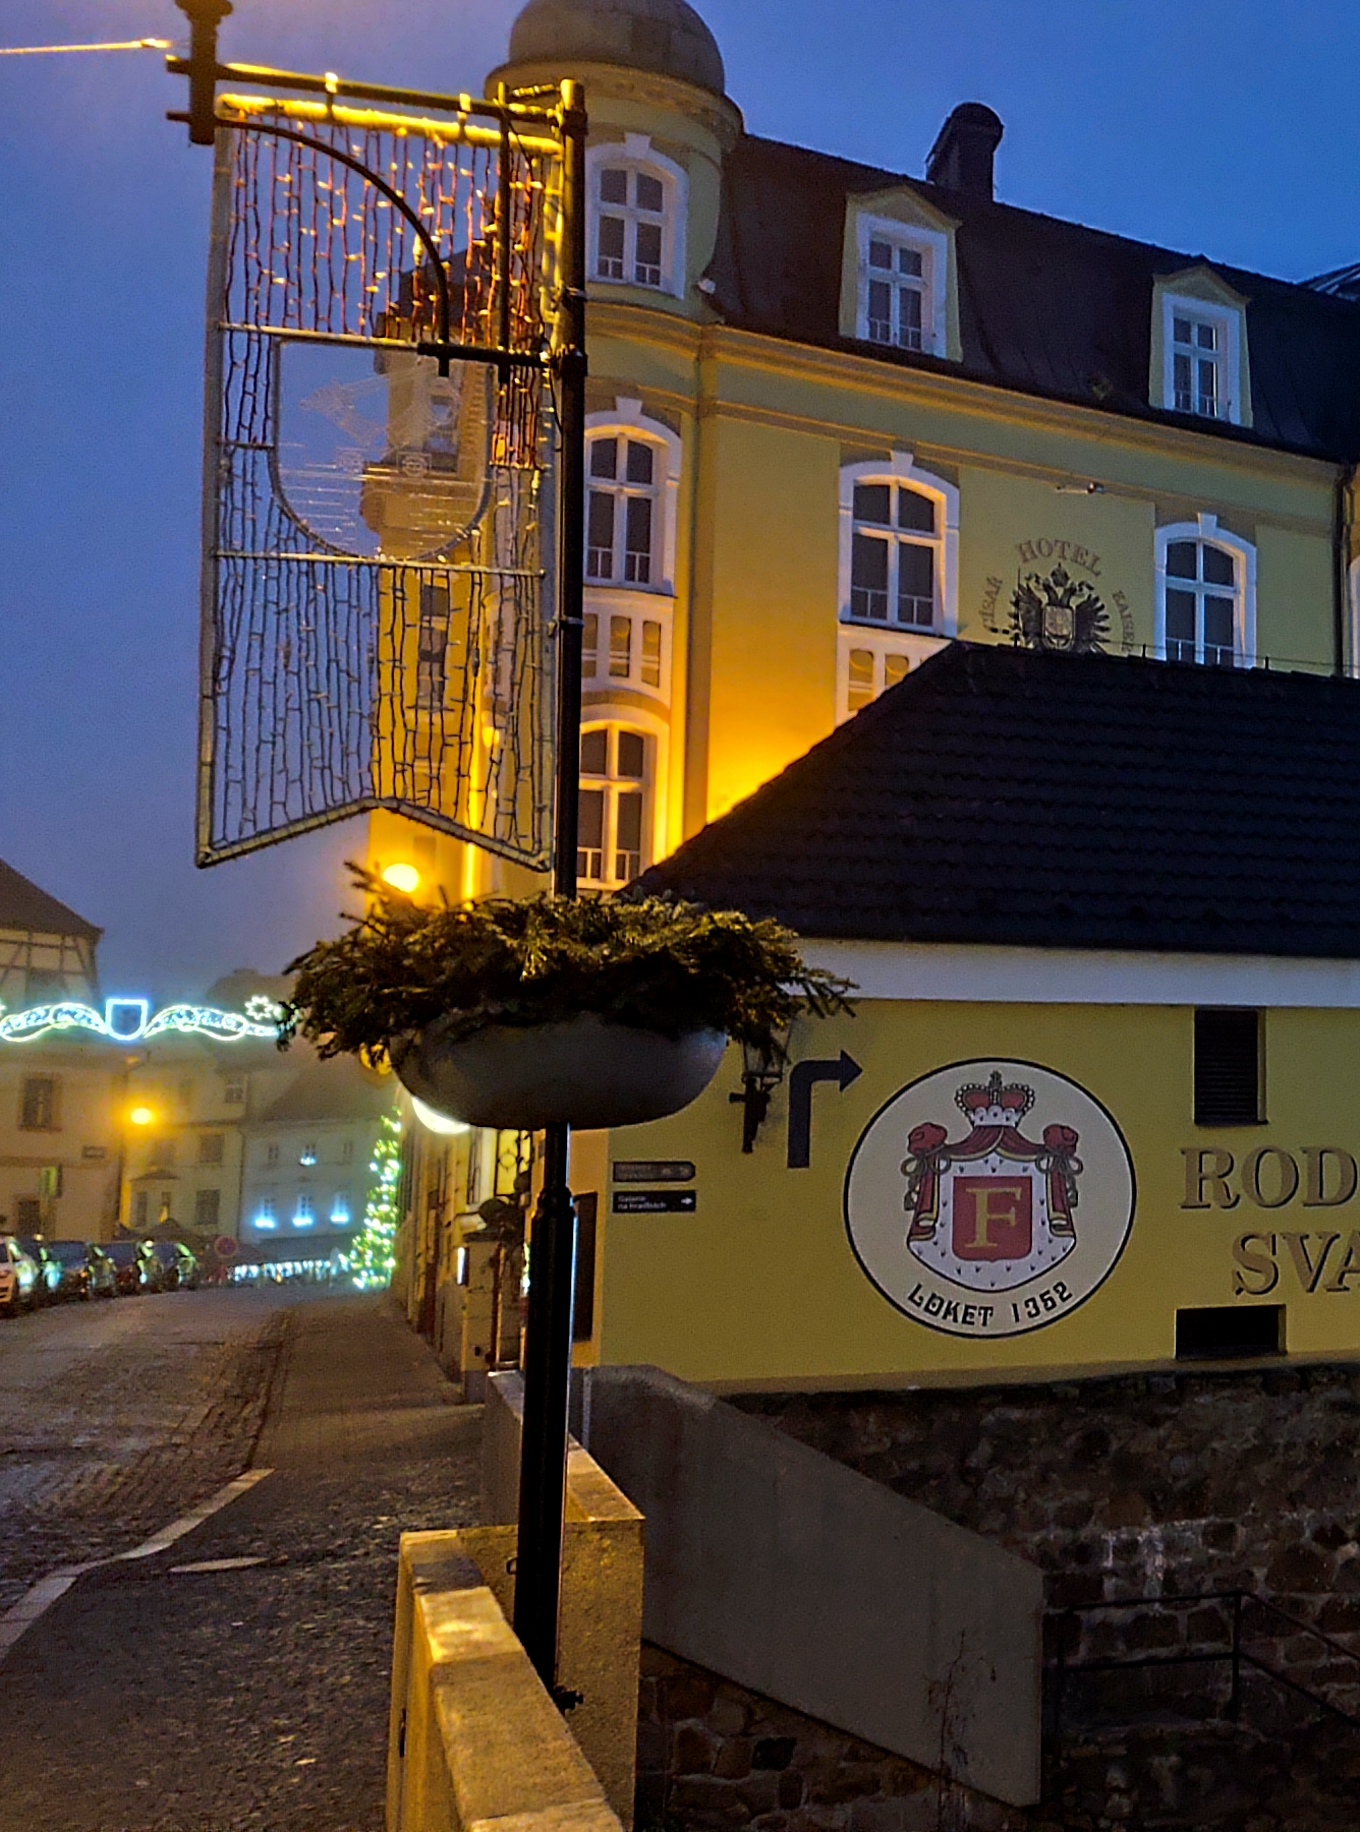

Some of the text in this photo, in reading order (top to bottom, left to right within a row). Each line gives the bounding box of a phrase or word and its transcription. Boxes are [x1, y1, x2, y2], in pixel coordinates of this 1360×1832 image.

[1016, 537, 1102, 578] HOTEL
[964, 1187, 1022, 1249] F
[907, 1281, 1073, 1327] LOKET 1352
